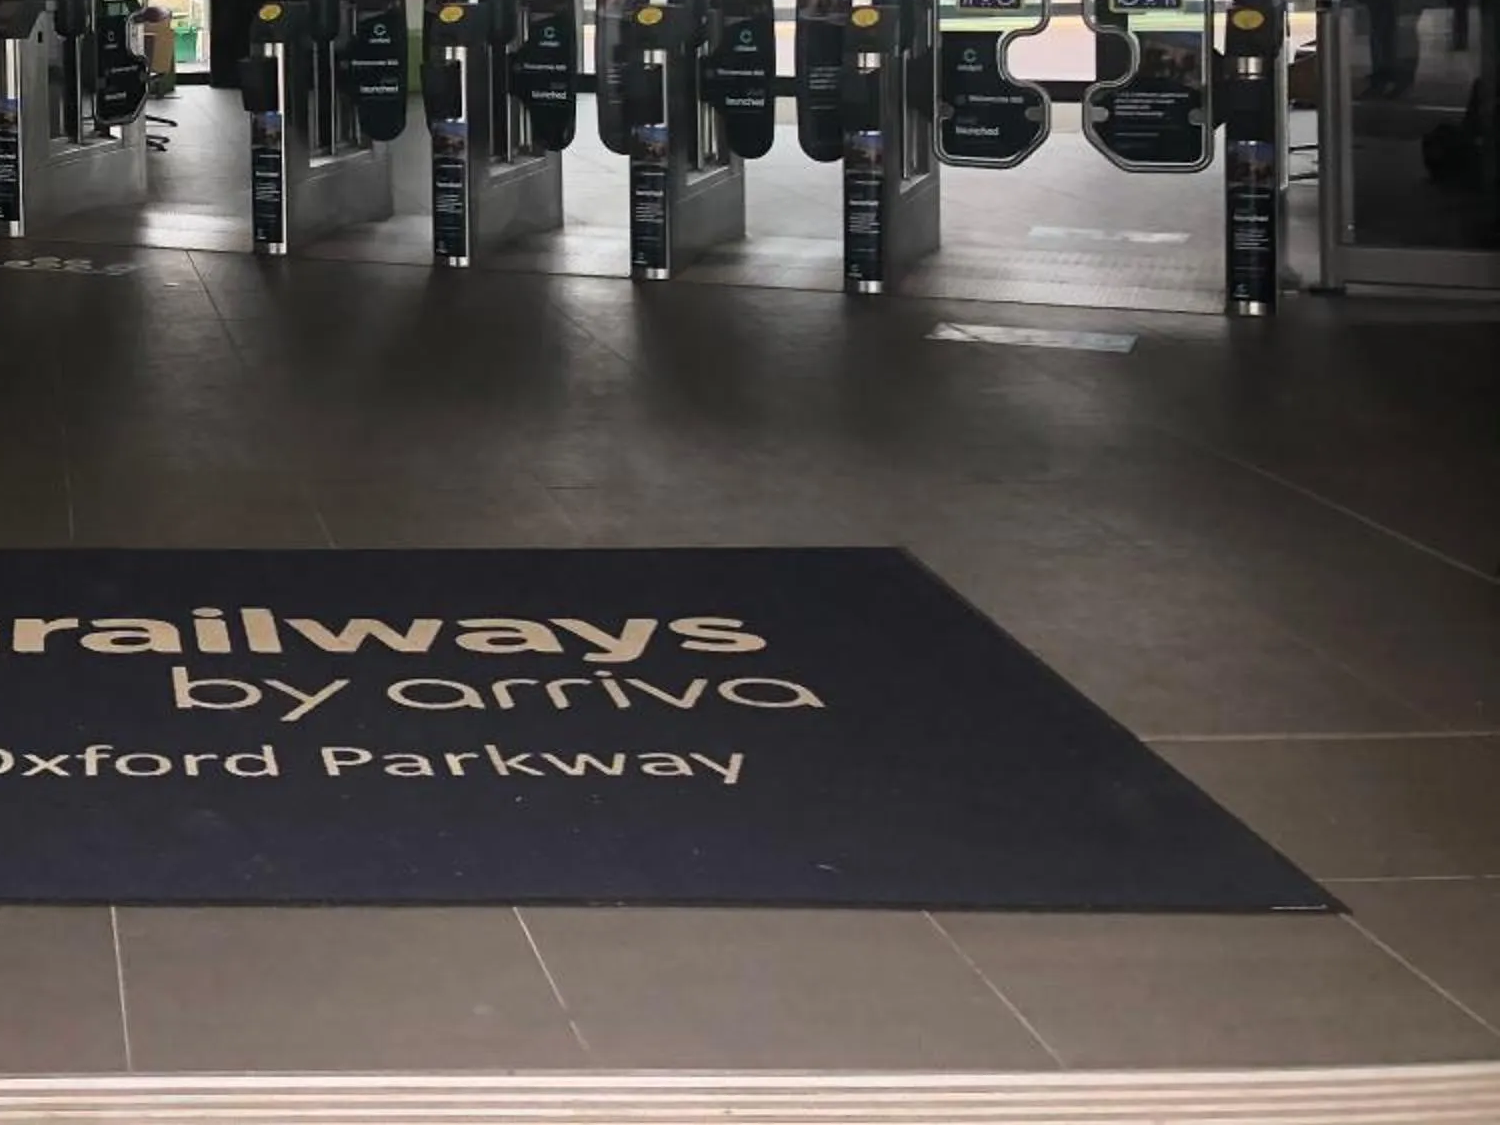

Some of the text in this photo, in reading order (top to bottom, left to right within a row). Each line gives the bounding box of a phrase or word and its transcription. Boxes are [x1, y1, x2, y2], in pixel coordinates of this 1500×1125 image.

[171, 666, 825, 722] by arriva
[320, 744, 744, 785] Parkway
